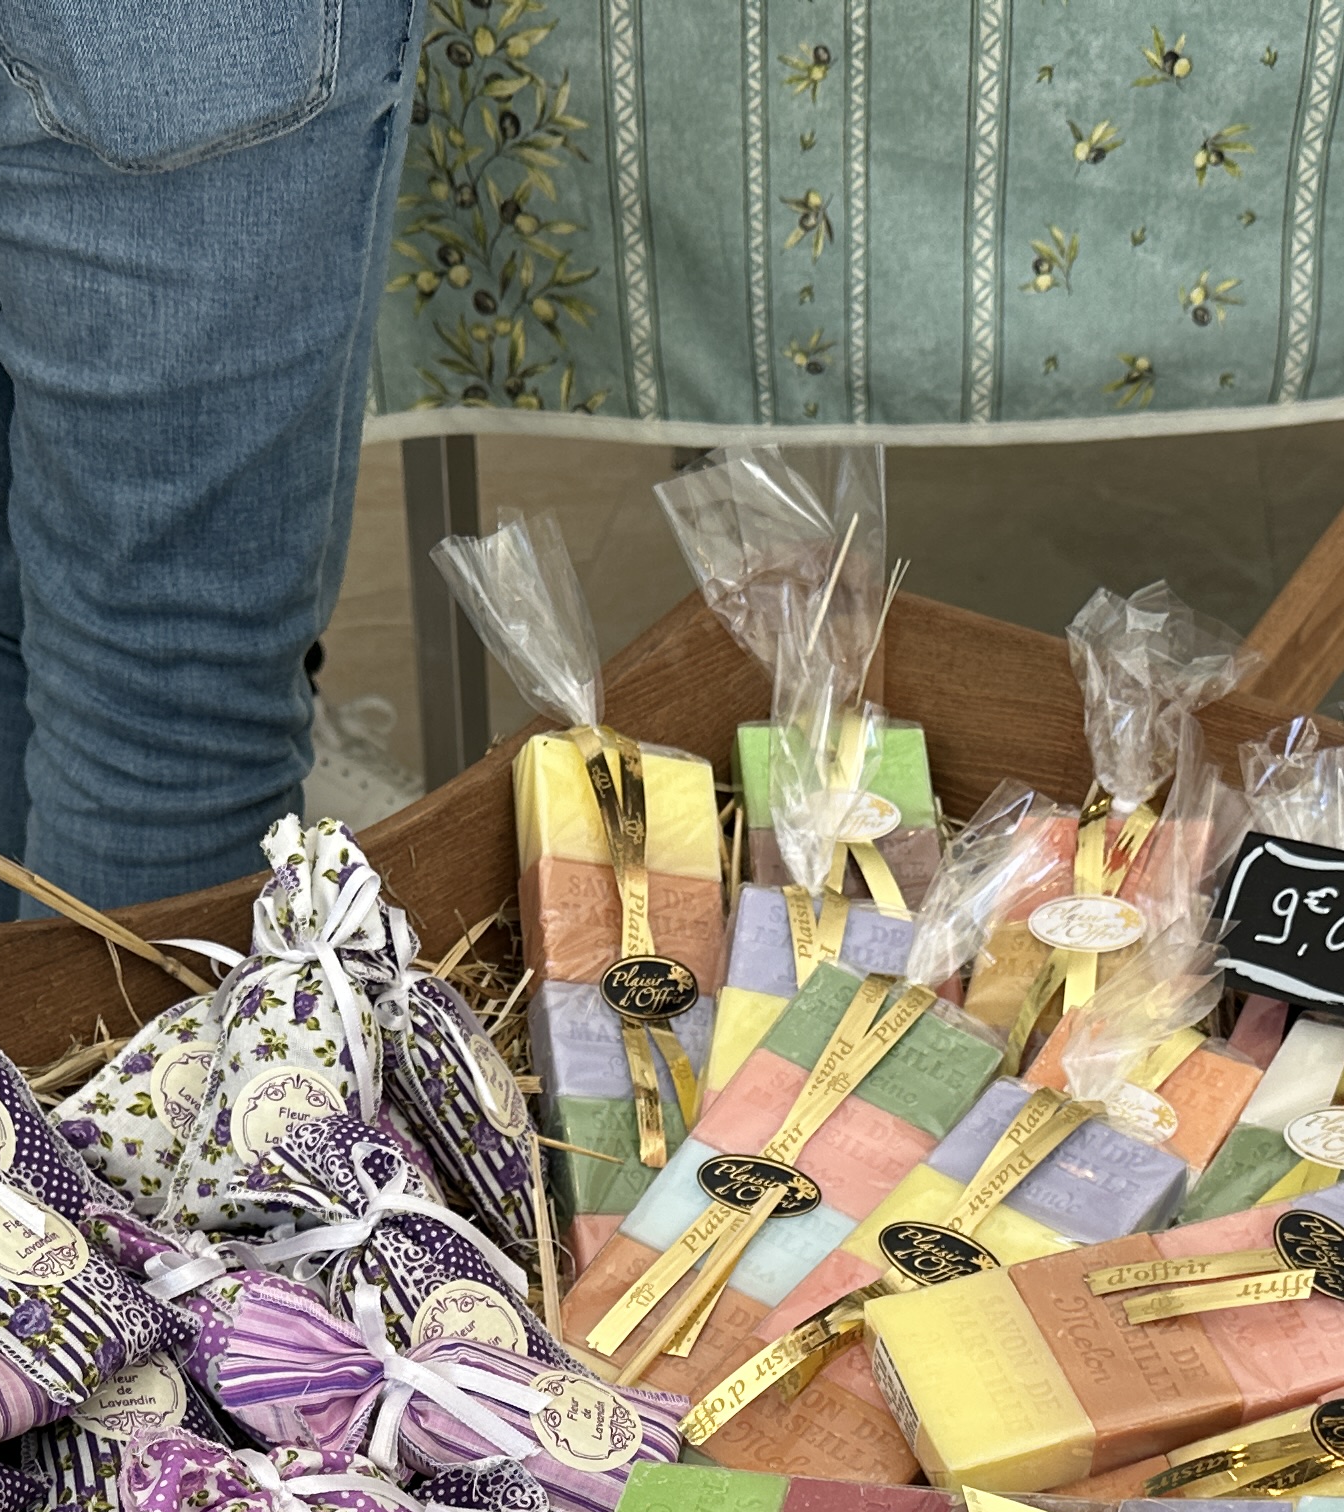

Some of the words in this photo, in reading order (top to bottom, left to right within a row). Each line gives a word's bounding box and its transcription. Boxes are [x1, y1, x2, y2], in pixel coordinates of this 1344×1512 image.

[1046, 902, 1108, 928] Plaisir
[611, 964, 665, 988] Plaisir
[618, 986, 686, 1014] d'Offrir
[177, 1086, 203, 1110] Lava
[278, 1106, 312, 1121] Fleur
[713, 1162, 786, 1190] Plaisir
[967, 1149, 1036, 1216] Plaisir
[3, 1221, 26, 1234] Fle
[15, 1231, 61, 1260] Lavandin
[897, 1226, 966, 1263] Plaisir
[1106, 1258, 1212, 1287] d'offrir
[1282, 1231, 1344, 1293] d'Offrir
[100, 1374, 139, 1385] leur
[116, 1385, 133, 1396] de
[99, 1395, 157, 1410] Lavandin
[566, 1396, 580, 1422] Fleur
[582, 1406, 593, 1420] de
[591, 1400, 606, 1441] Lavandin
